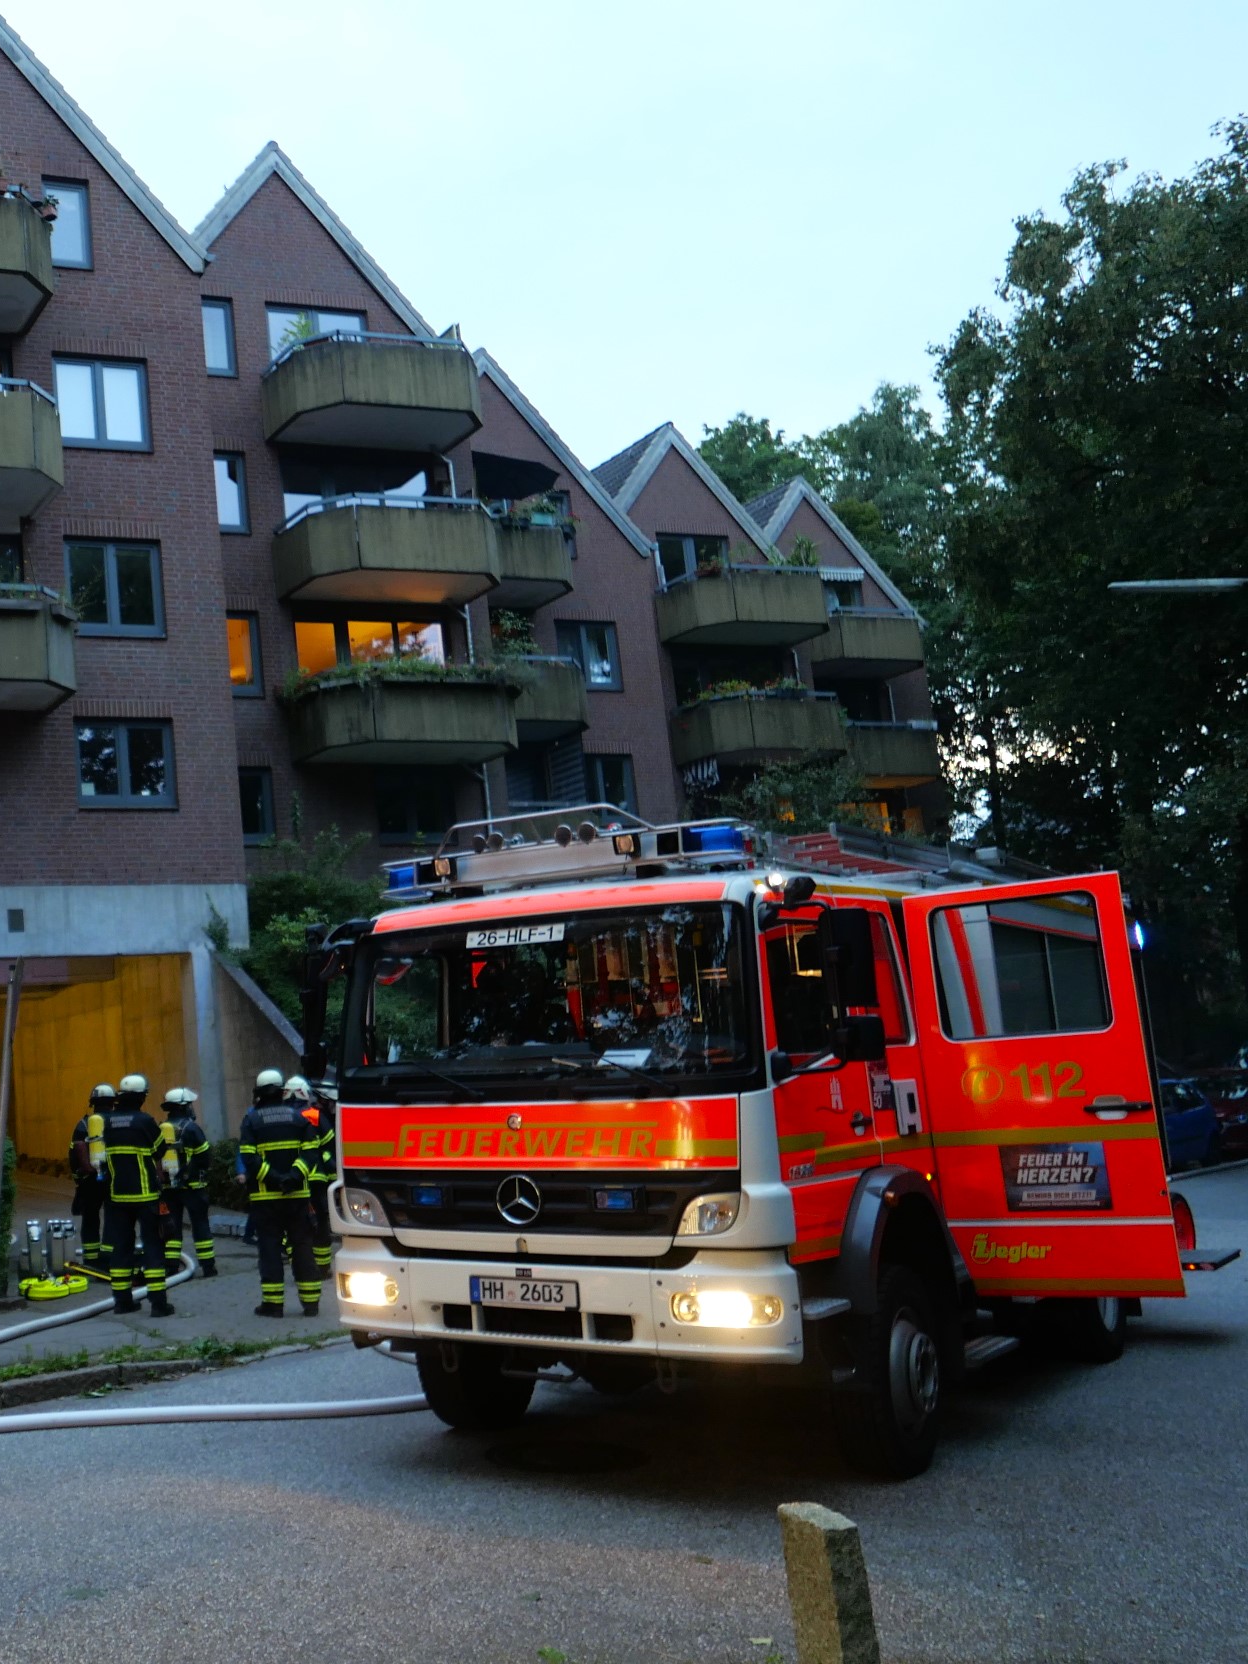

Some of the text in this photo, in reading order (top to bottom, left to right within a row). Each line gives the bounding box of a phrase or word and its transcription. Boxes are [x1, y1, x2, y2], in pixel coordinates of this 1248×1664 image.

[477, 926, 554, 946] 26-HLF-1
[1010, 1061, 1086, 1100] 112
[397, 1122, 657, 1158] FEUERWEHR
[1018, 1151, 1084, 1167] FEUER IM
[1016, 1166, 1094, 1184] HERZEN?
[482, 1281, 504, 1299] HH
[520, 1283, 564, 1302] 2603
